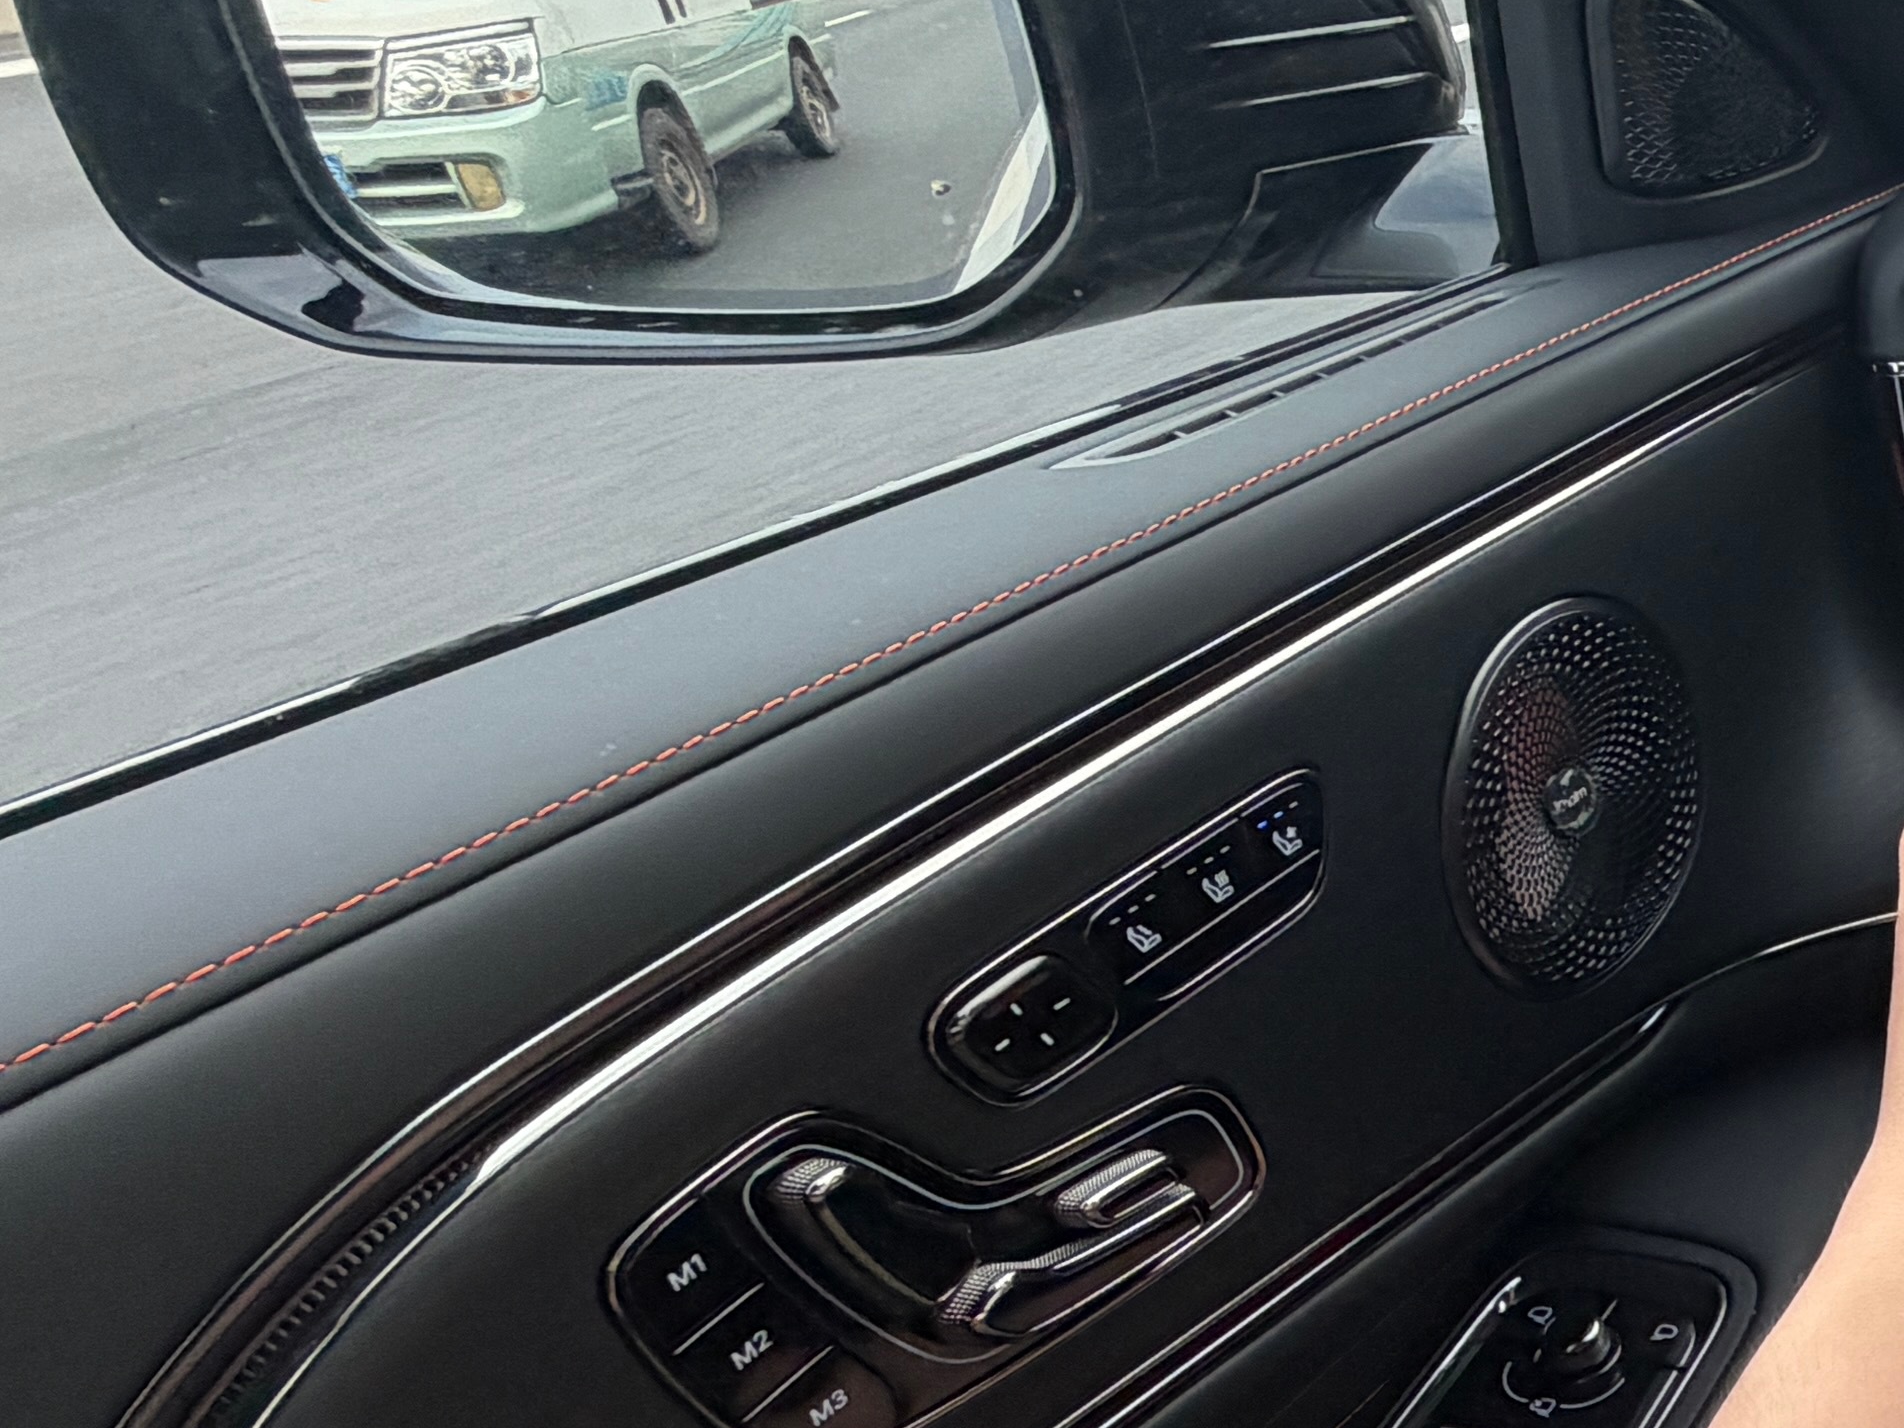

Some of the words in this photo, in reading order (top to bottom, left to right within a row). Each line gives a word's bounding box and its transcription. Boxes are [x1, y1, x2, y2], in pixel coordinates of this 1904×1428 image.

[667, 1253, 707, 1292] M1
[730, 1329, 773, 1370] M2
[809, 1388, 848, 1427] M3
